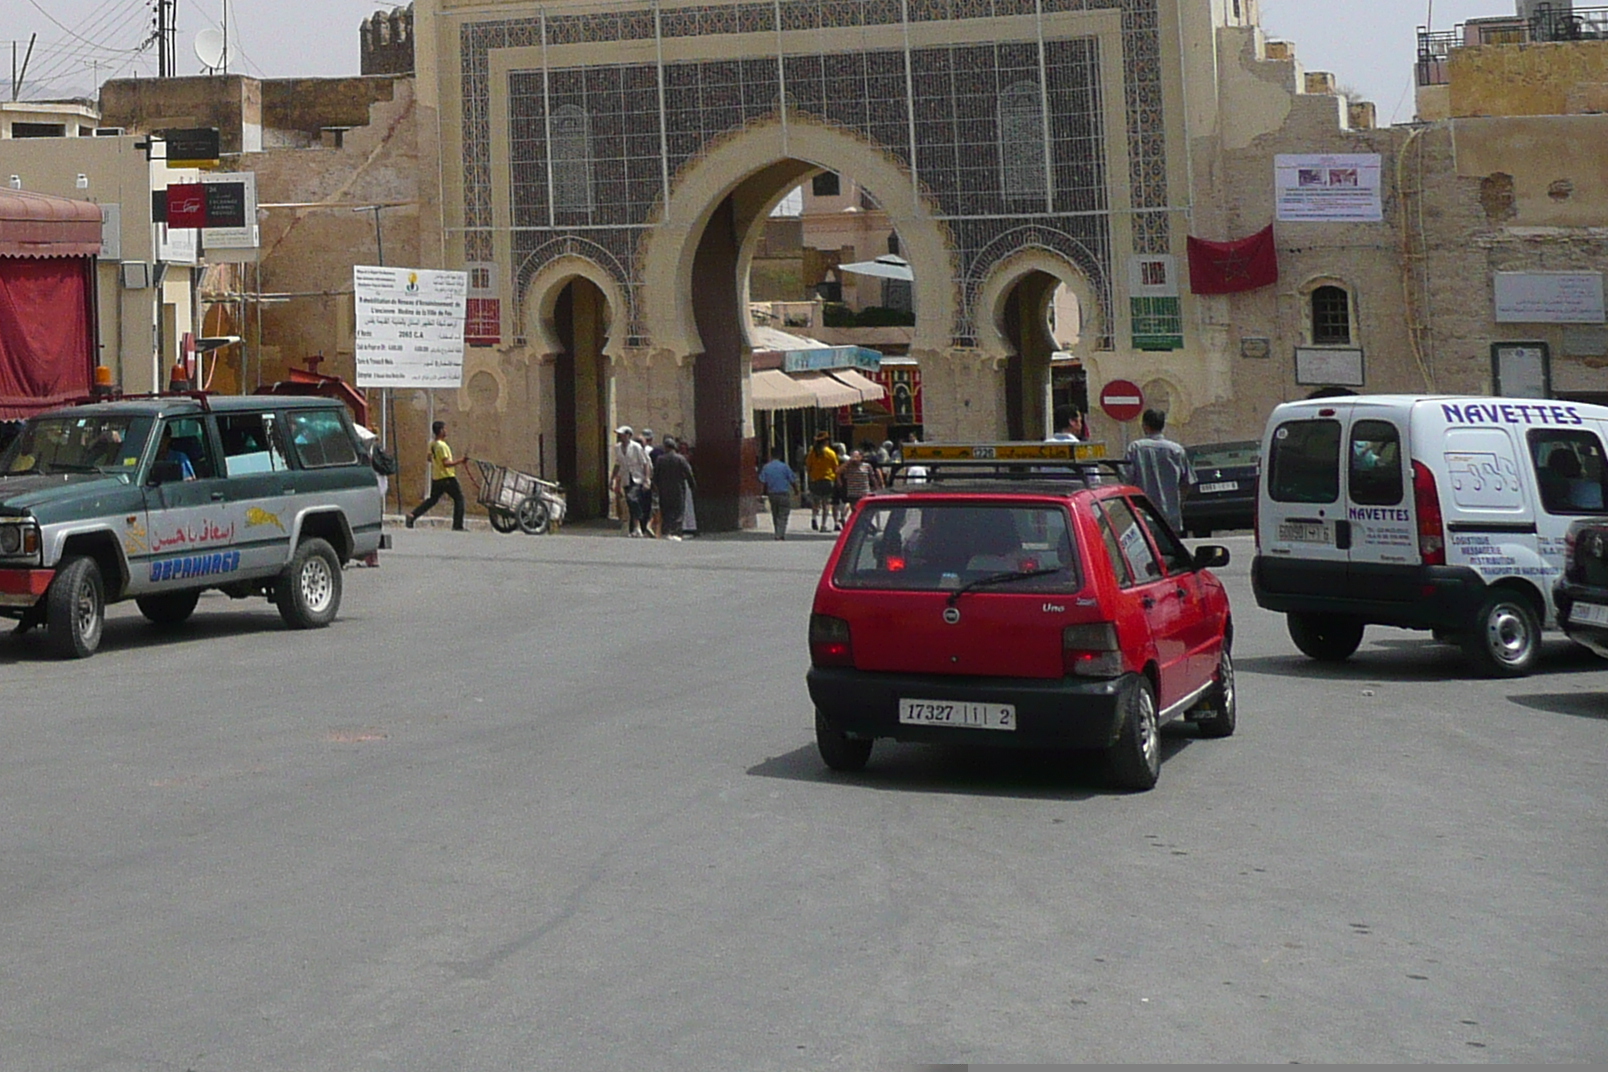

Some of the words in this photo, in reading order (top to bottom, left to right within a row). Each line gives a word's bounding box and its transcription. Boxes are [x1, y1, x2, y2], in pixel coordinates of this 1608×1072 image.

[1441, 404, 1583, 425] NAVETTES
[1348, 507, 1410, 521] NAVETTES
[150, 550, 241, 583] DEPANNAGE
[1042, 602, 1065, 613] Uno
[906, 704, 954, 721] 17327
[999, 708, 1010, 725] 2
